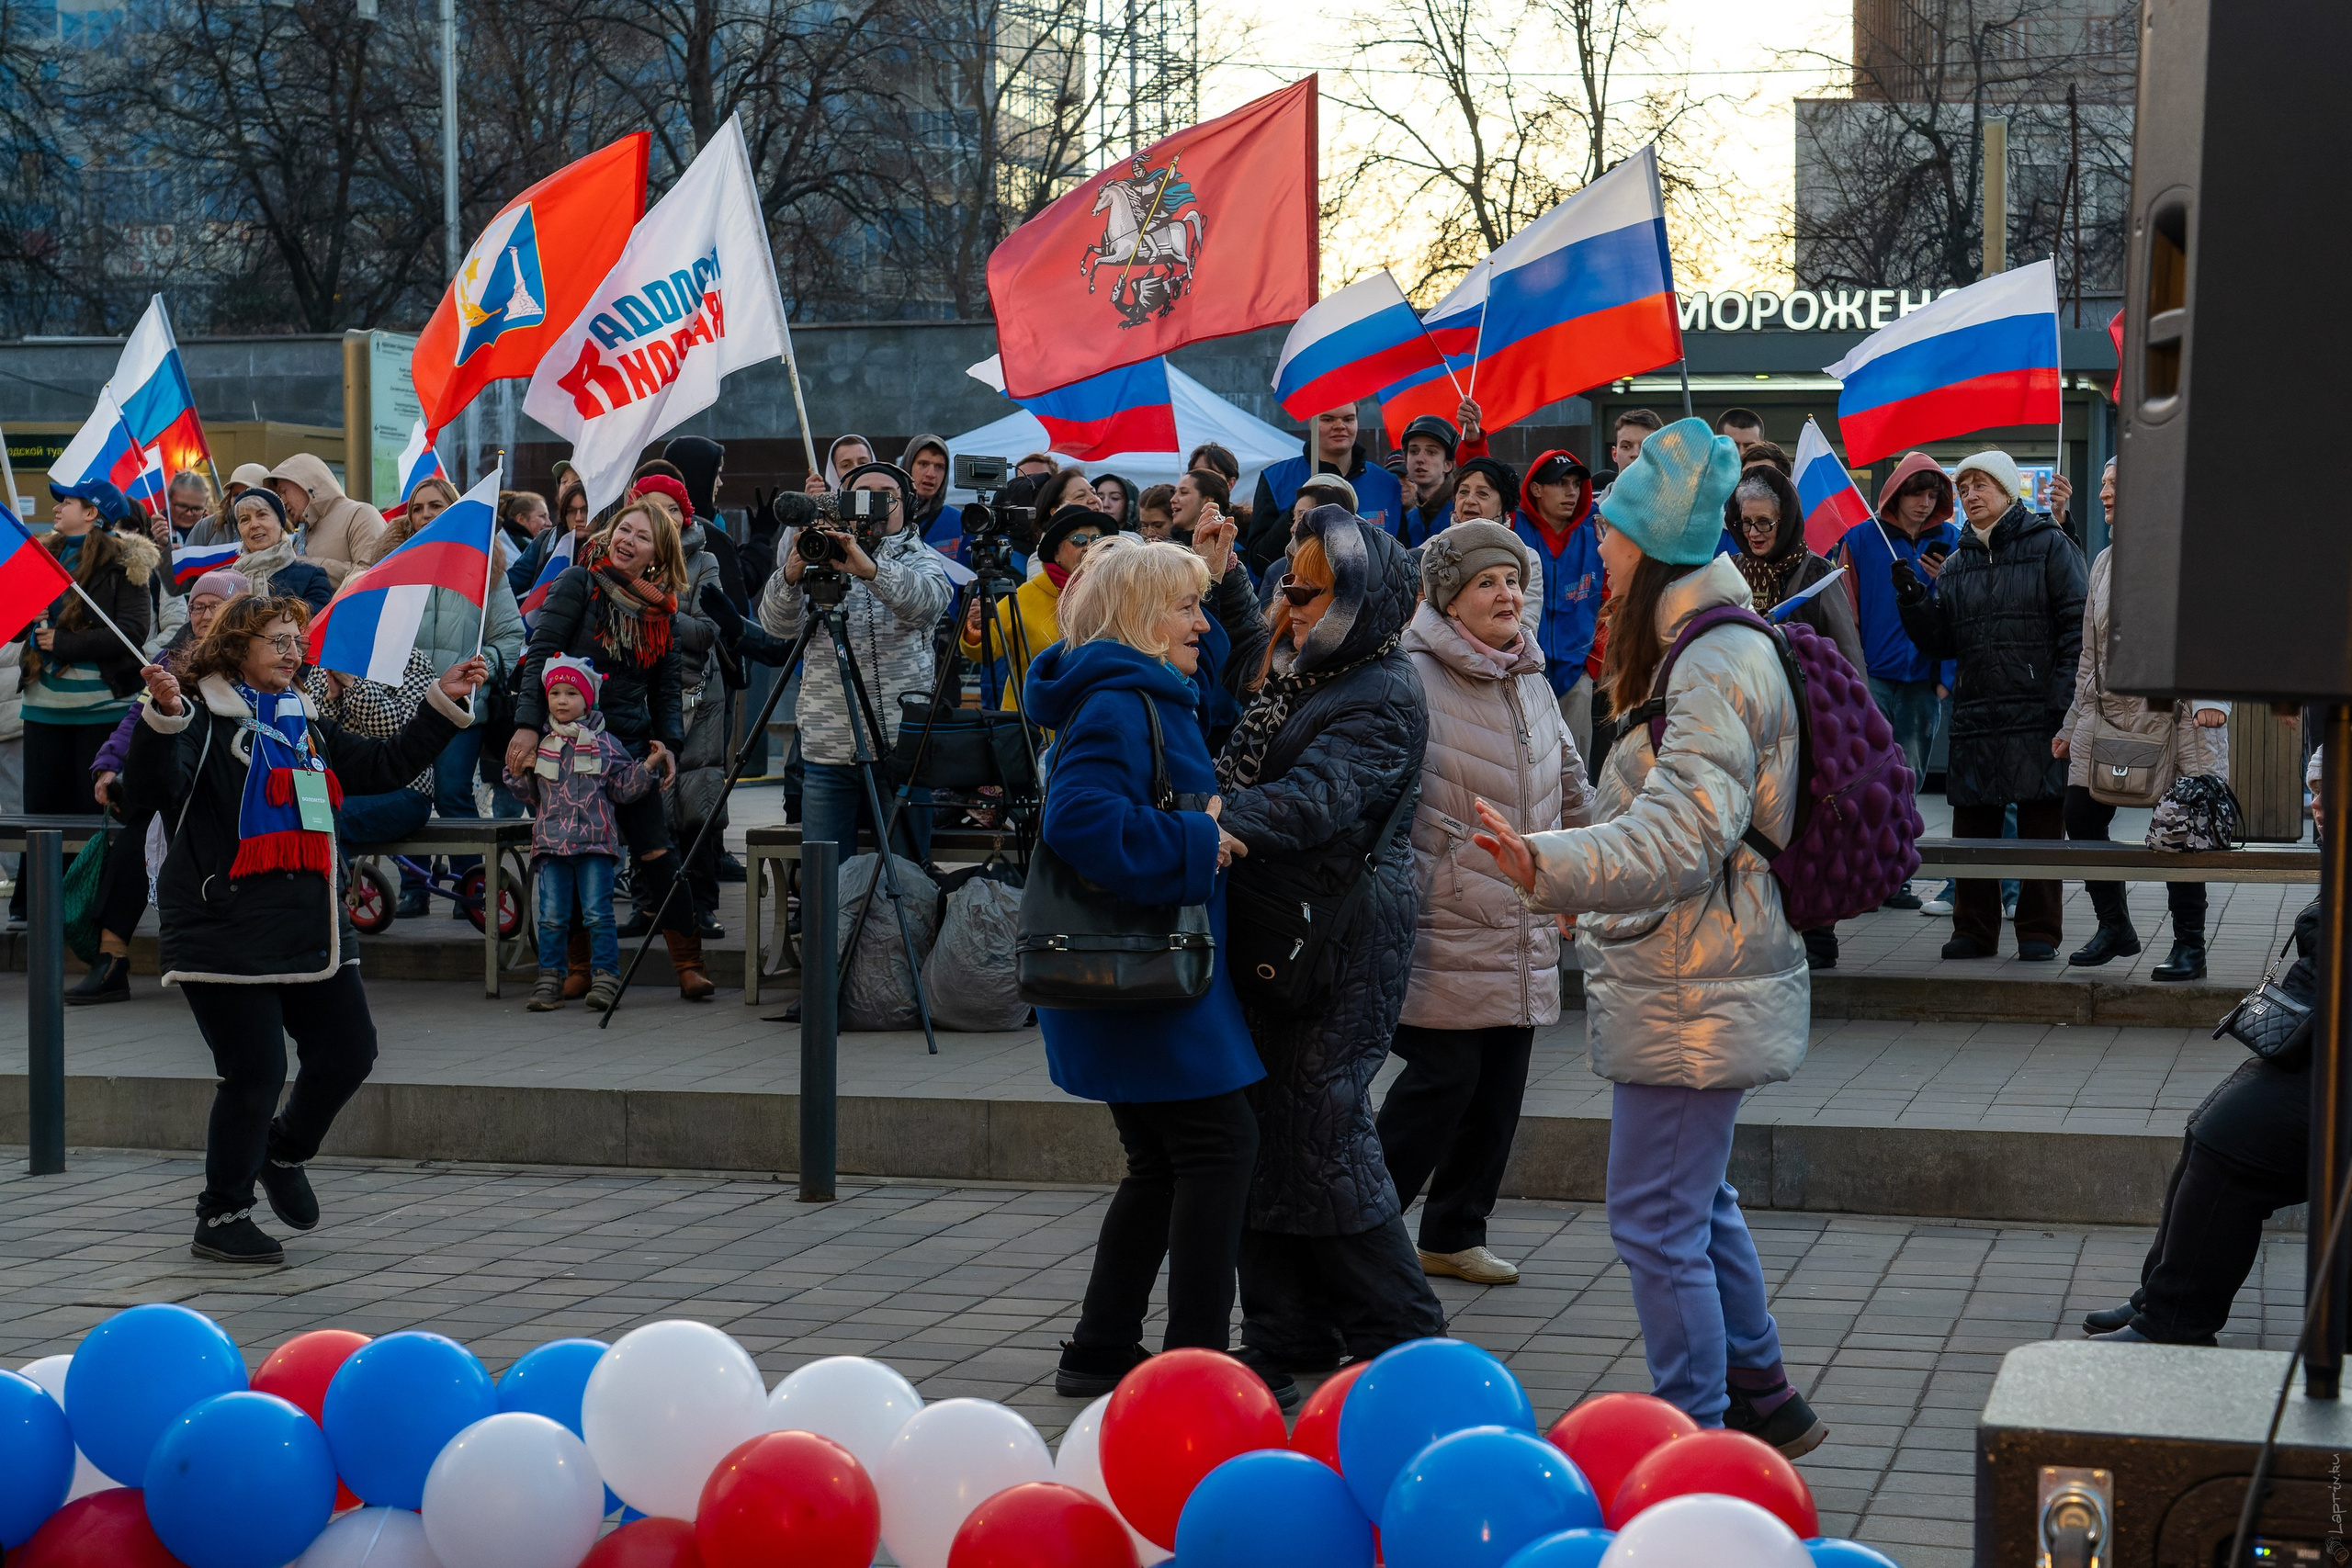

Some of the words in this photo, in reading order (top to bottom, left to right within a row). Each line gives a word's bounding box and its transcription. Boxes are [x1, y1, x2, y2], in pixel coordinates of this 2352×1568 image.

[1675, 288, 1962, 333] МОРОЖЕН
[6, 446, 43, 457] одской
[46, 447, 63, 457] туа
